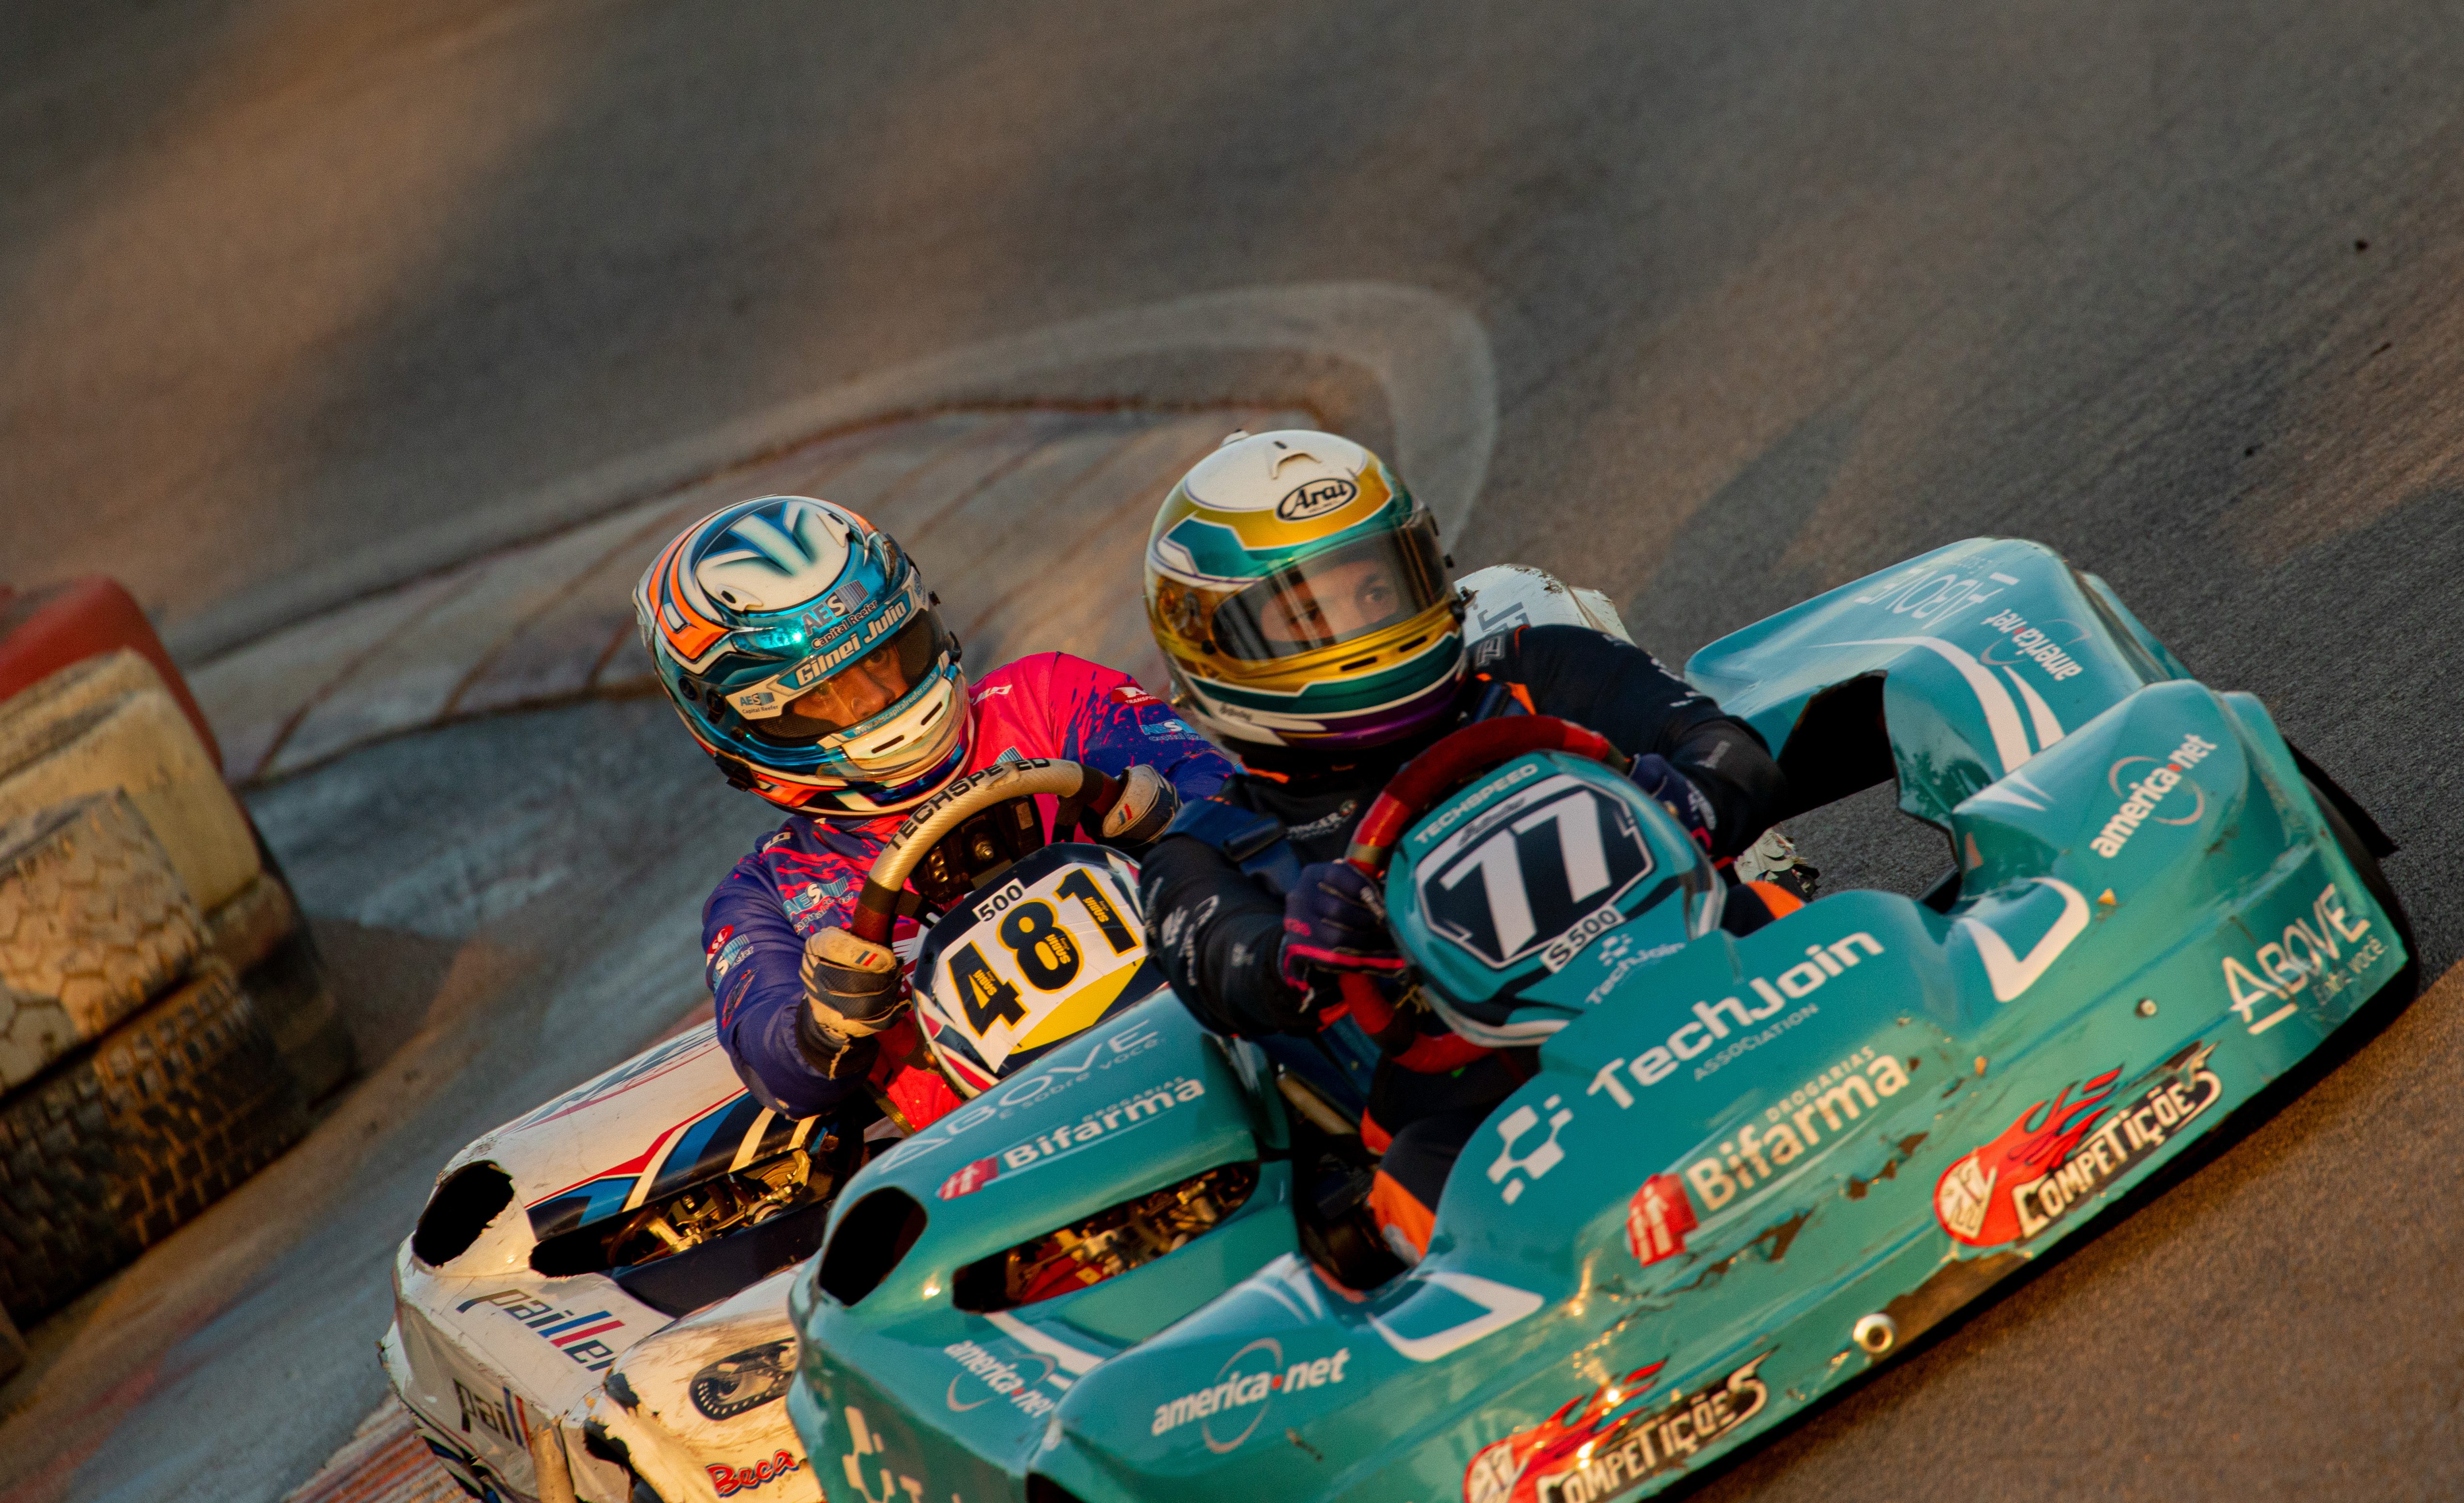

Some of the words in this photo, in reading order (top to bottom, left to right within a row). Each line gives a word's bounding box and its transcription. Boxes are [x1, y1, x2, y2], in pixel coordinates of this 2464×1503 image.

[1284, 480, 1347, 517] Arai
[796, 633, 861, 685] Gilnei
[864, 601, 907, 643] Julio
[801, 595, 848, 637] AES
[811, 620, 849, 649] Capital
[848, 600, 878, 625] Reefer
[740, 694, 762, 706] AES
[886, 758, 1051, 850] TECHSPEED
[1413, 763, 1538, 844] TECHSPEED
[782, 883, 822, 922] AES
[978, 884, 1023, 922] 500
[1440, 790, 1611, 960] 77
[947, 867, 1143, 1041] 481
[1550, 910, 1617, 967] S500
[1584, 942, 1685, 1004] TechJoin
[2223, 882, 2370, 1022] ABOVE
[1587, 932, 1884, 1109] TechJoin
[1693, 1003, 1819, 1082] ASSOCIATION
[880, 1019, 1157, 1175] ABOVE
[1003, 1078, 1204, 1169] Bifarma
[1766, 1045, 1875, 1122] DROGARIAS
[1686, 1055, 1909, 1212] Bifarma
